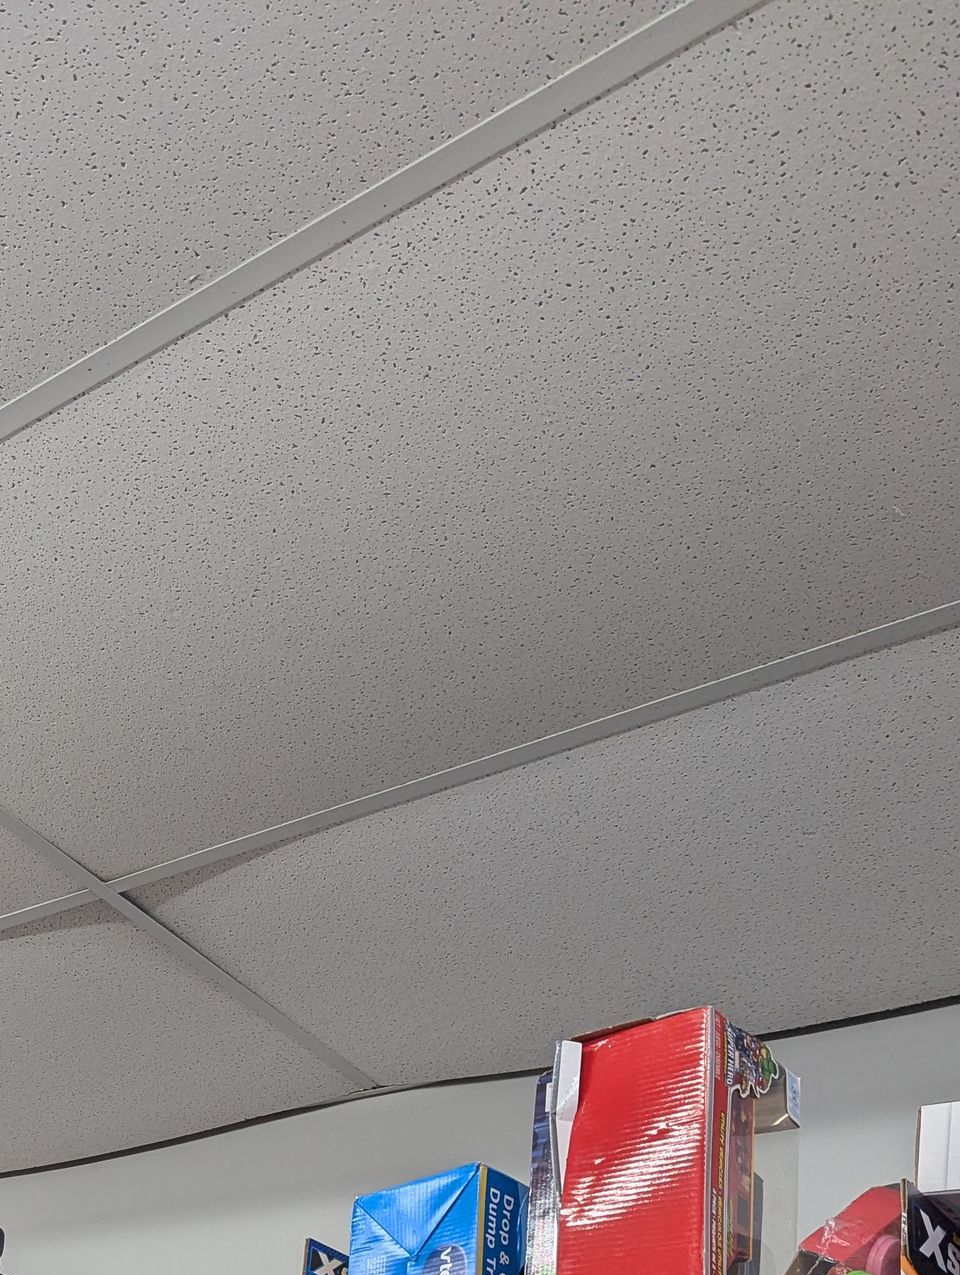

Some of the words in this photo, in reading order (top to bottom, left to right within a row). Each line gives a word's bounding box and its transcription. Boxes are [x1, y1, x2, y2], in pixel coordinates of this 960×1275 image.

[486, 1187, 500, 1248] Dump
[501, 1194, 514, 1236] Drop
[499, 1252, 510, 1266] &
